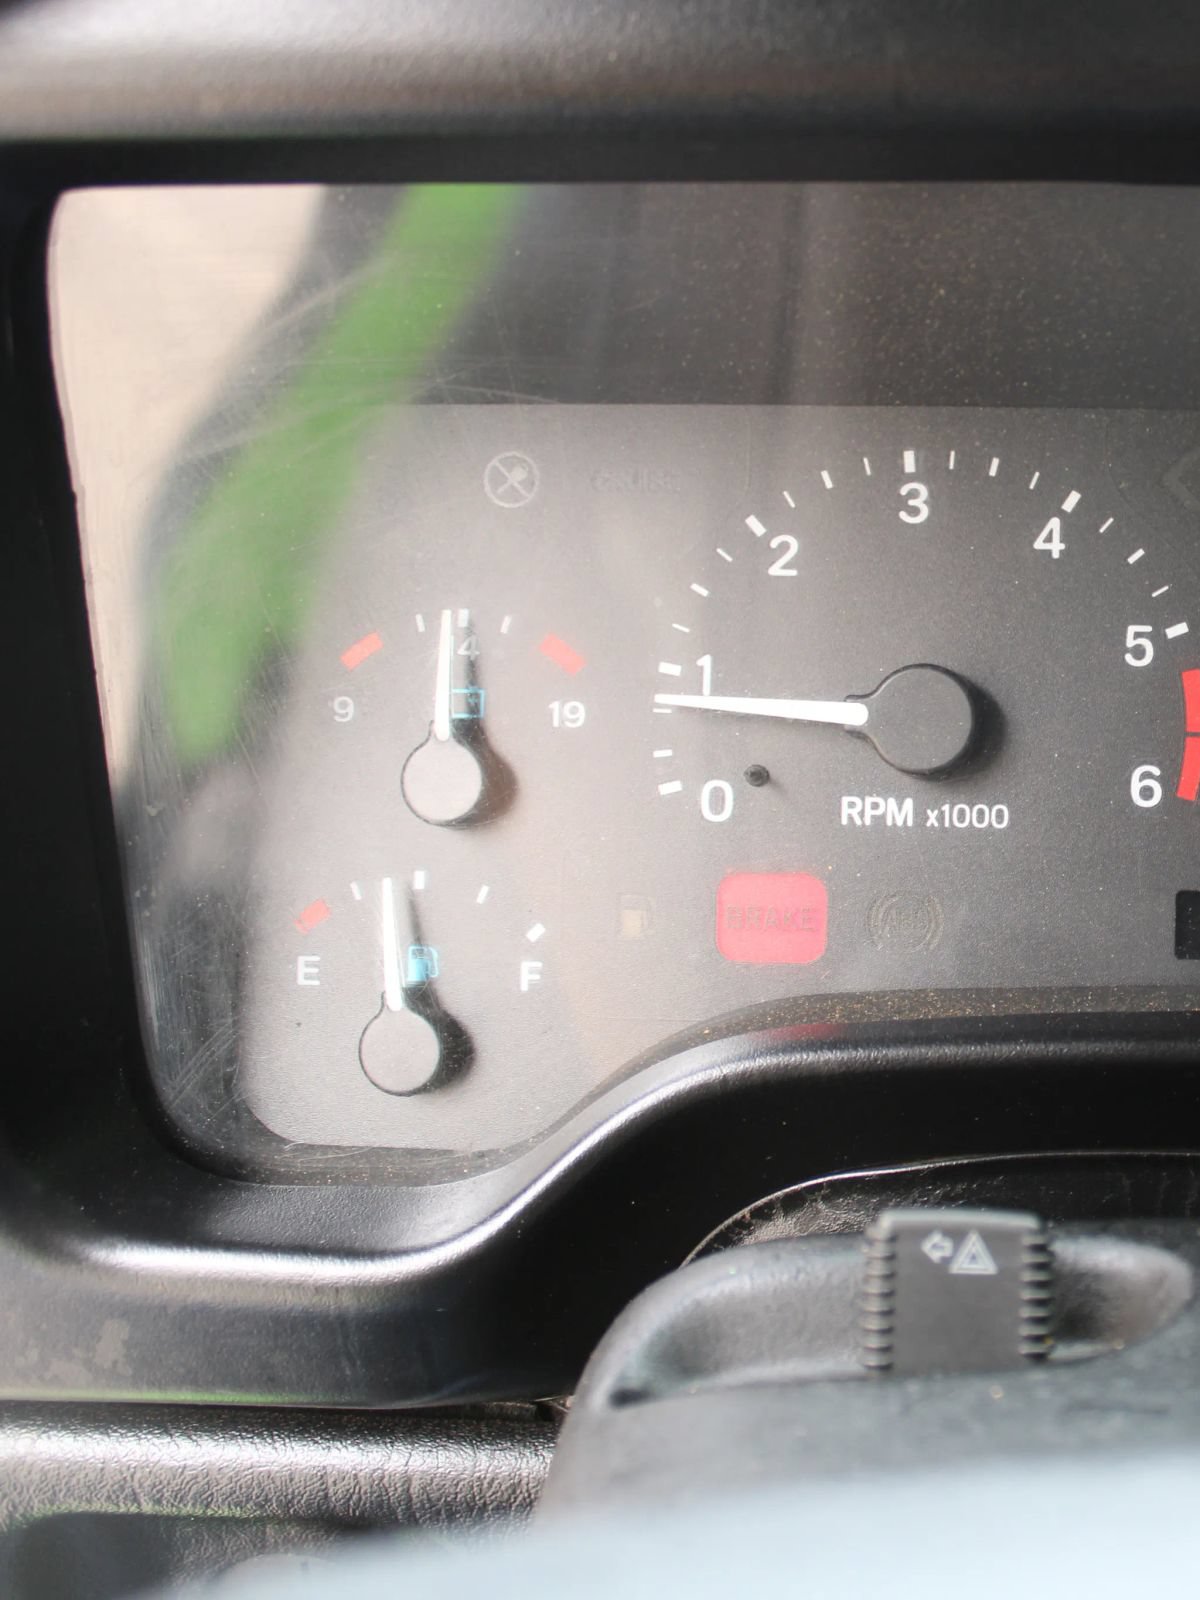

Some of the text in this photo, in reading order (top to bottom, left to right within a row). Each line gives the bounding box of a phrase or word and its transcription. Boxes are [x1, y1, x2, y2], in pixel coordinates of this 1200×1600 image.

[898, 482, 929, 524] 3
[767, 534, 799, 577] 2
[1032, 516, 1066, 559] 4
[1124, 624, 1154, 667] 5
[695, 654, 712, 695] 1
[333, 695, 355, 723] 9
[548, 700, 586, 729] 19
[700, 779, 735, 823] 0
[1130, 764, 1163, 808] 6
[840, 795, 1010, 829] RPM x1000
[726, 906, 819, 932] BRAKE
[296, 955, 321, 986] E
[519, 960, 543, 992] F
